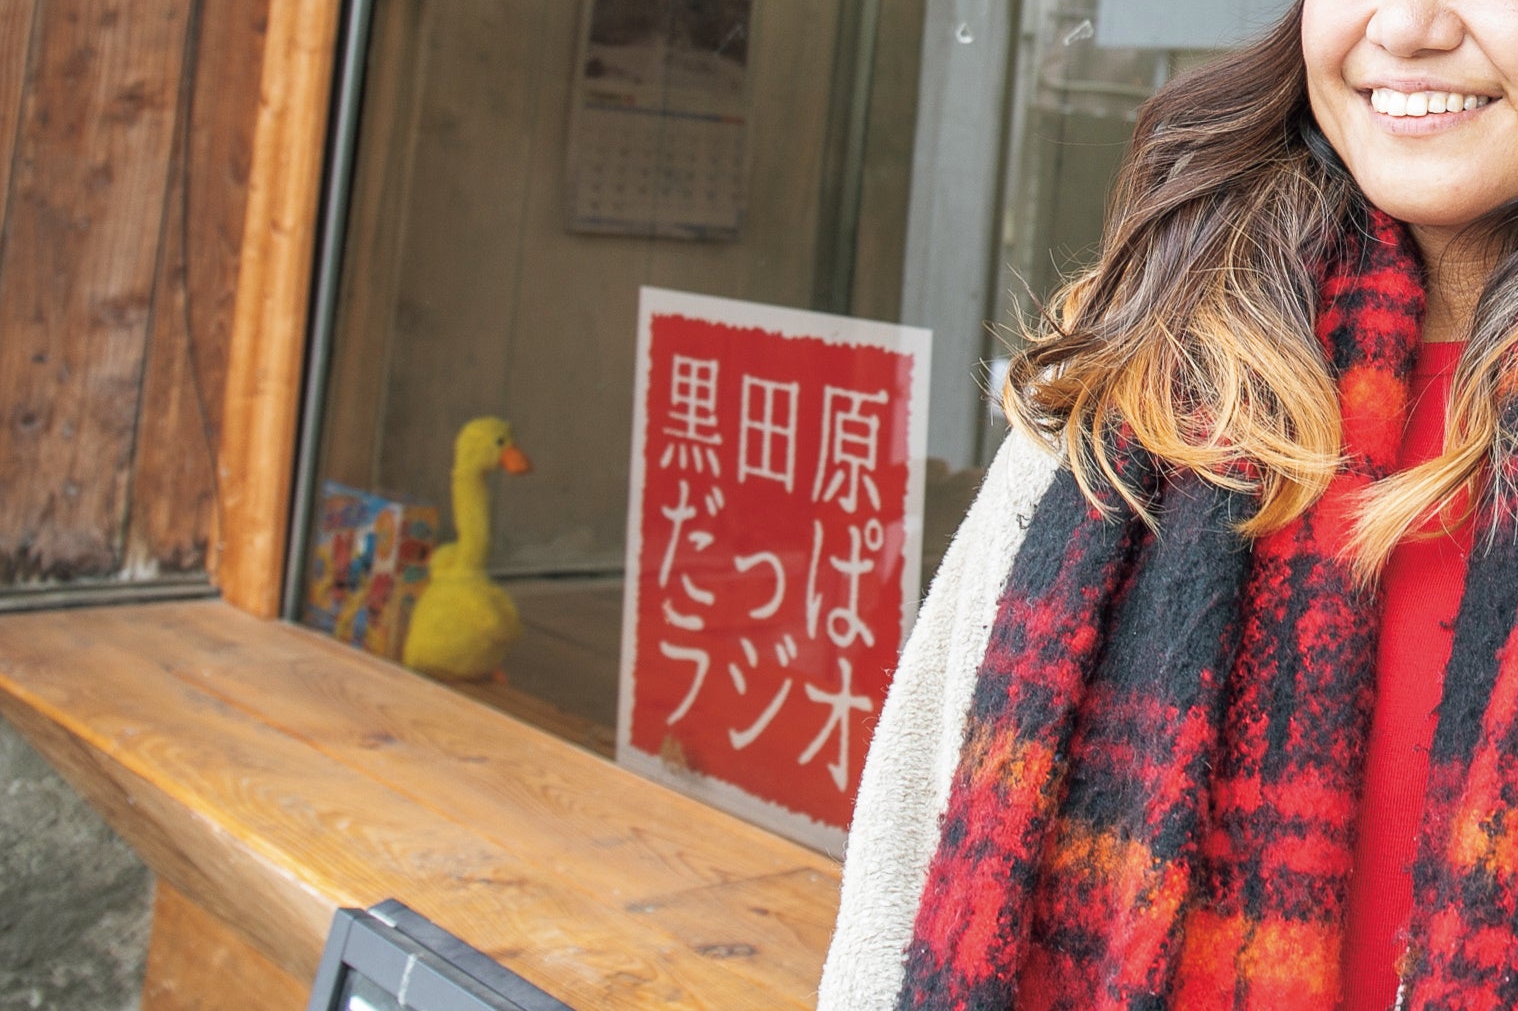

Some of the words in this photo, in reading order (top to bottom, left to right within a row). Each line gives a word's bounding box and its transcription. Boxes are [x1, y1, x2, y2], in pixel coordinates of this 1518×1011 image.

[660, 354, 890, 514] 黒田原
[658, 598, 876, 793] ラジオ
